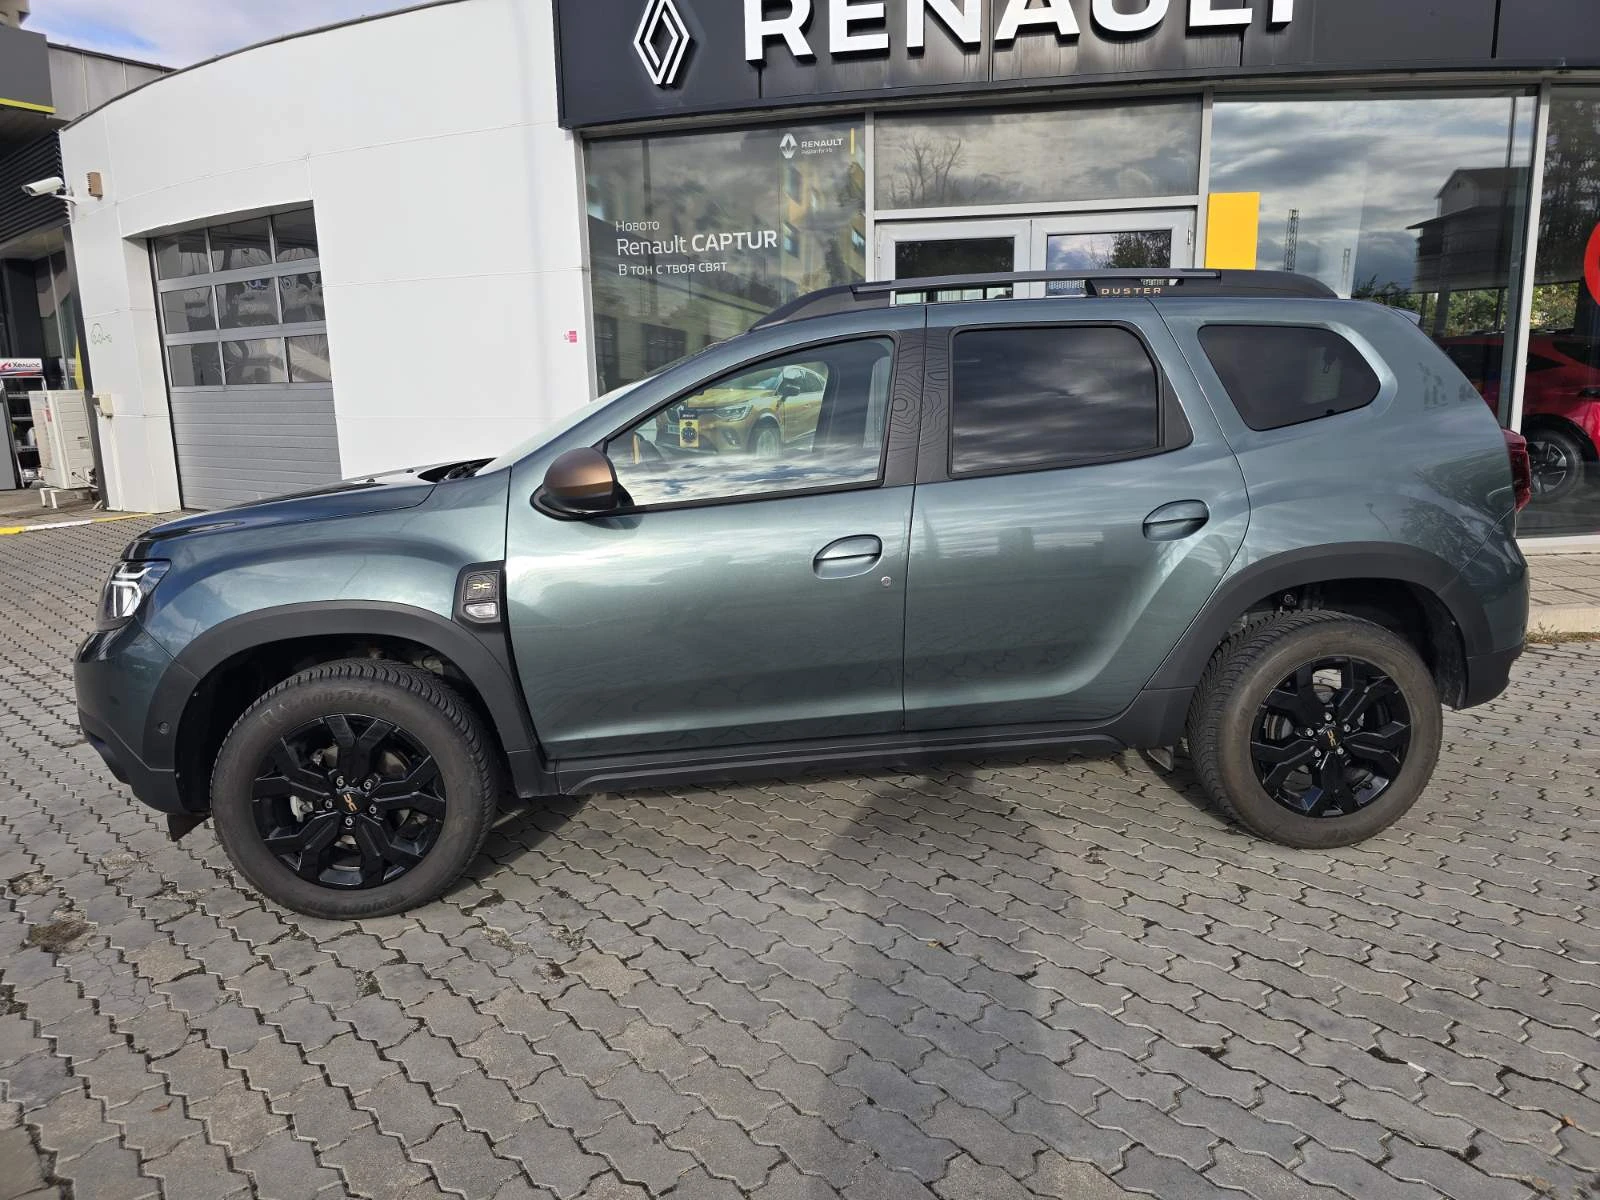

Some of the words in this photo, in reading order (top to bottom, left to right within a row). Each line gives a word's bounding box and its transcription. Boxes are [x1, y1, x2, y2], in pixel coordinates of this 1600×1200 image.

[745, 0, 1292, 61] RENA
[801, 138, 843, 148] RENAULT
[615, 220, 660, 232] Новото
[616, 235, 687, 256] Renault
[691, 230, 777, 252] CAPTUR
[618, 264, 627, 276] В
[630, 265, 652, 275] тон
[656, 265, 663, 274] с
[665, 263, 695, 274] твоя
[698, 261, 727, 272] свят
[1101, 287, 1161, 295] DUSTER
